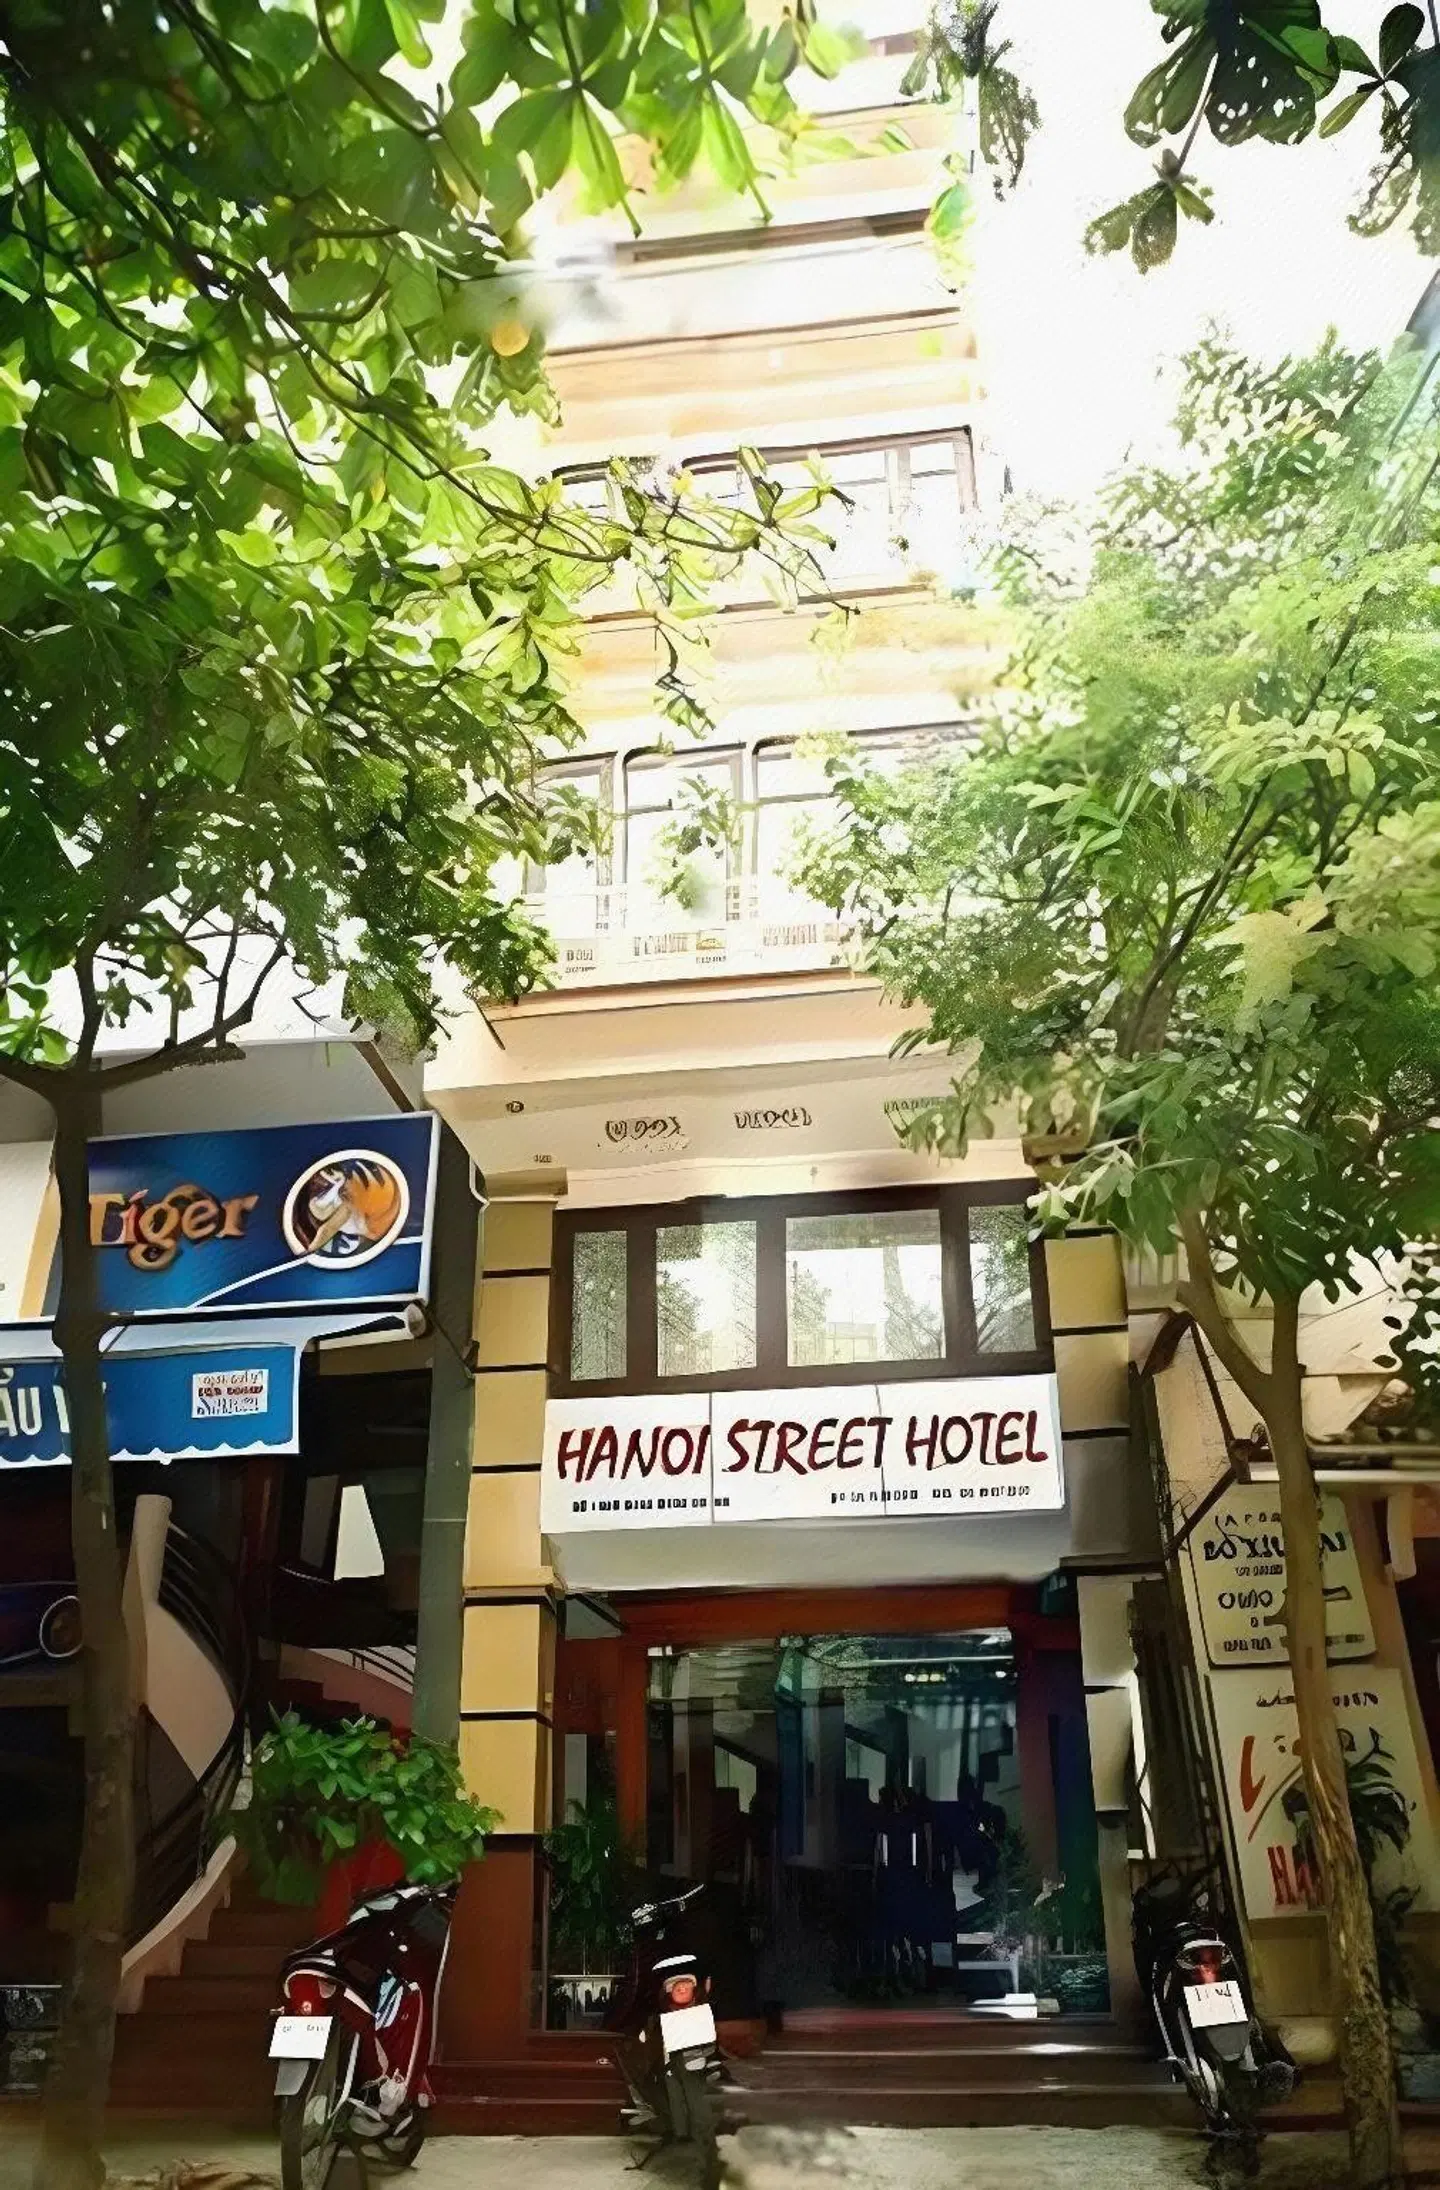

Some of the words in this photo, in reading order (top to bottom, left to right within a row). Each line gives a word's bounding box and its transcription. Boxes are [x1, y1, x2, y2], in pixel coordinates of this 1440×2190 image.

[89, 1184, 260, 1271] Tiger
[559, 1424, 709, 1482] HANOI
[722, 1417, 893, 1475] STREET
[905, 1410, 1049, 1471] HOTEL
